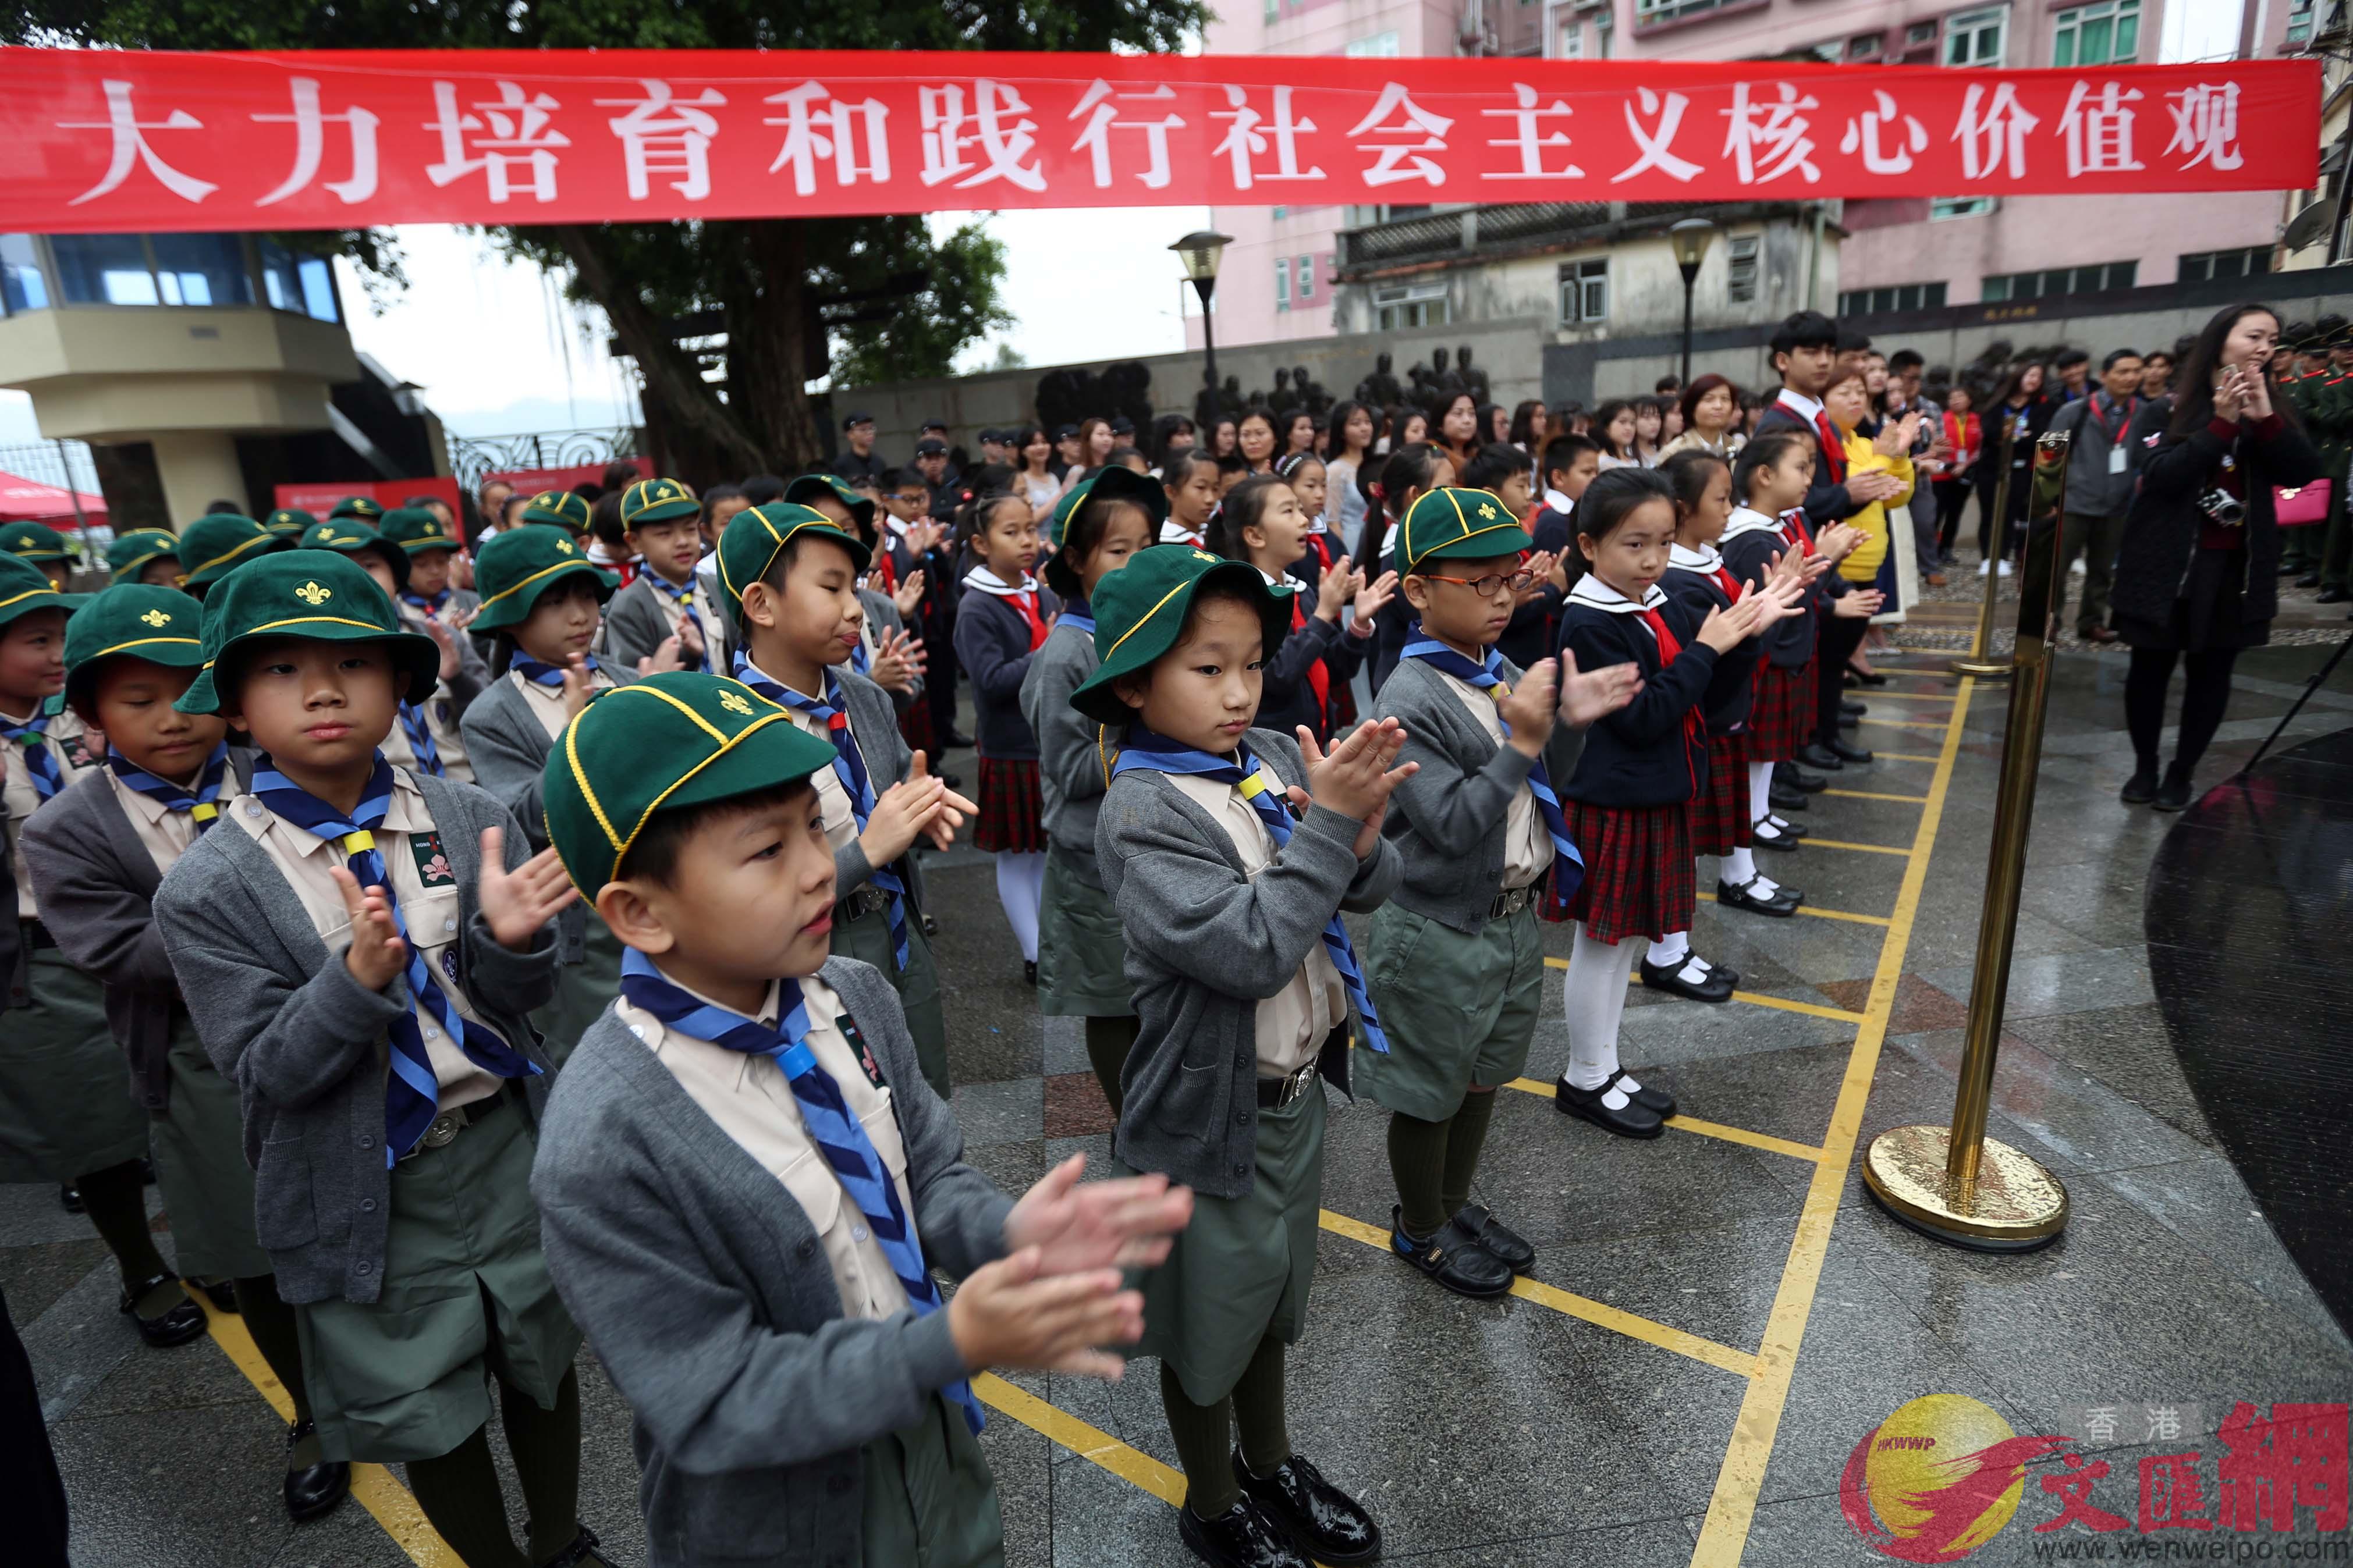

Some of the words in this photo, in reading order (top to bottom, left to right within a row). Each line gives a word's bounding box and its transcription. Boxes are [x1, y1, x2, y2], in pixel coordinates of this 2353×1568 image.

[55, 76, 2245, 207] 大力培育和践行社会主义核心价值观
